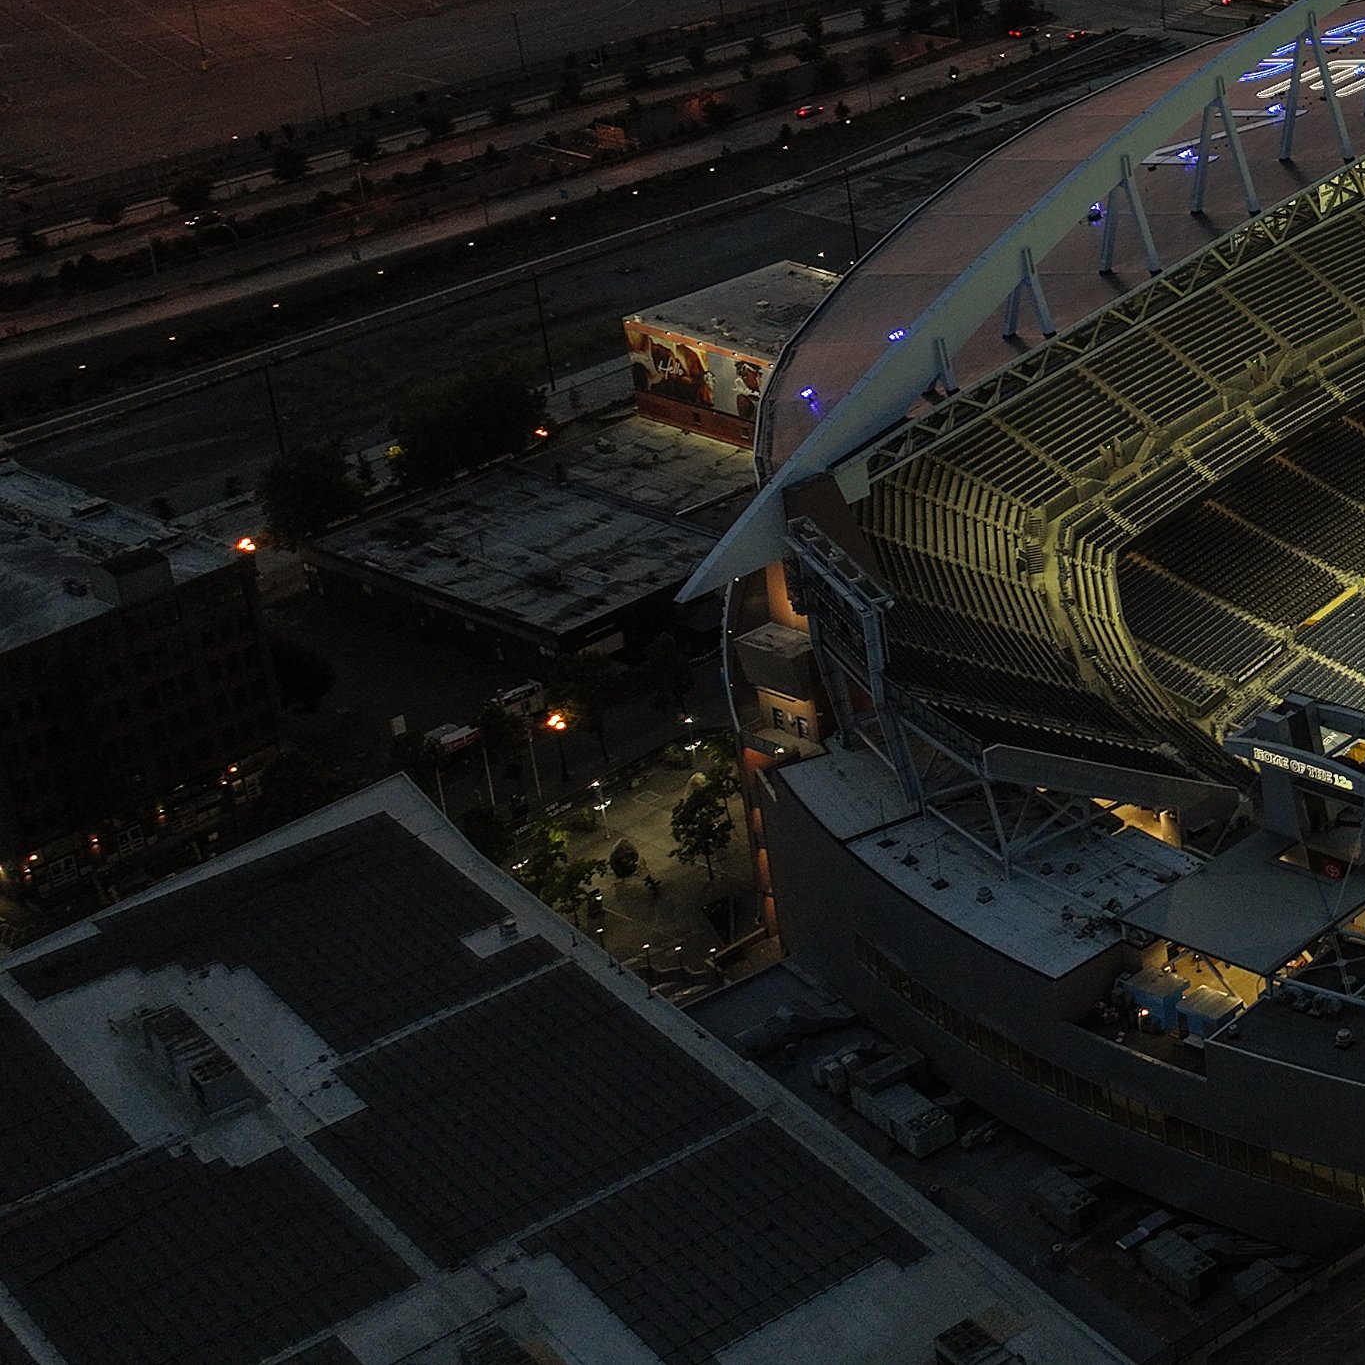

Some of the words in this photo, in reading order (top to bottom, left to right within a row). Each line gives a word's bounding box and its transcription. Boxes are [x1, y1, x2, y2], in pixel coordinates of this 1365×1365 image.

[657, 356, 684, 380] Hello
[1253, 747, 1290, 770] HOME
[1290, 759, 1307, 775] OF
[1307, 764, 1333, 785] THE
[1333, 773, 1354, 791] 12s
